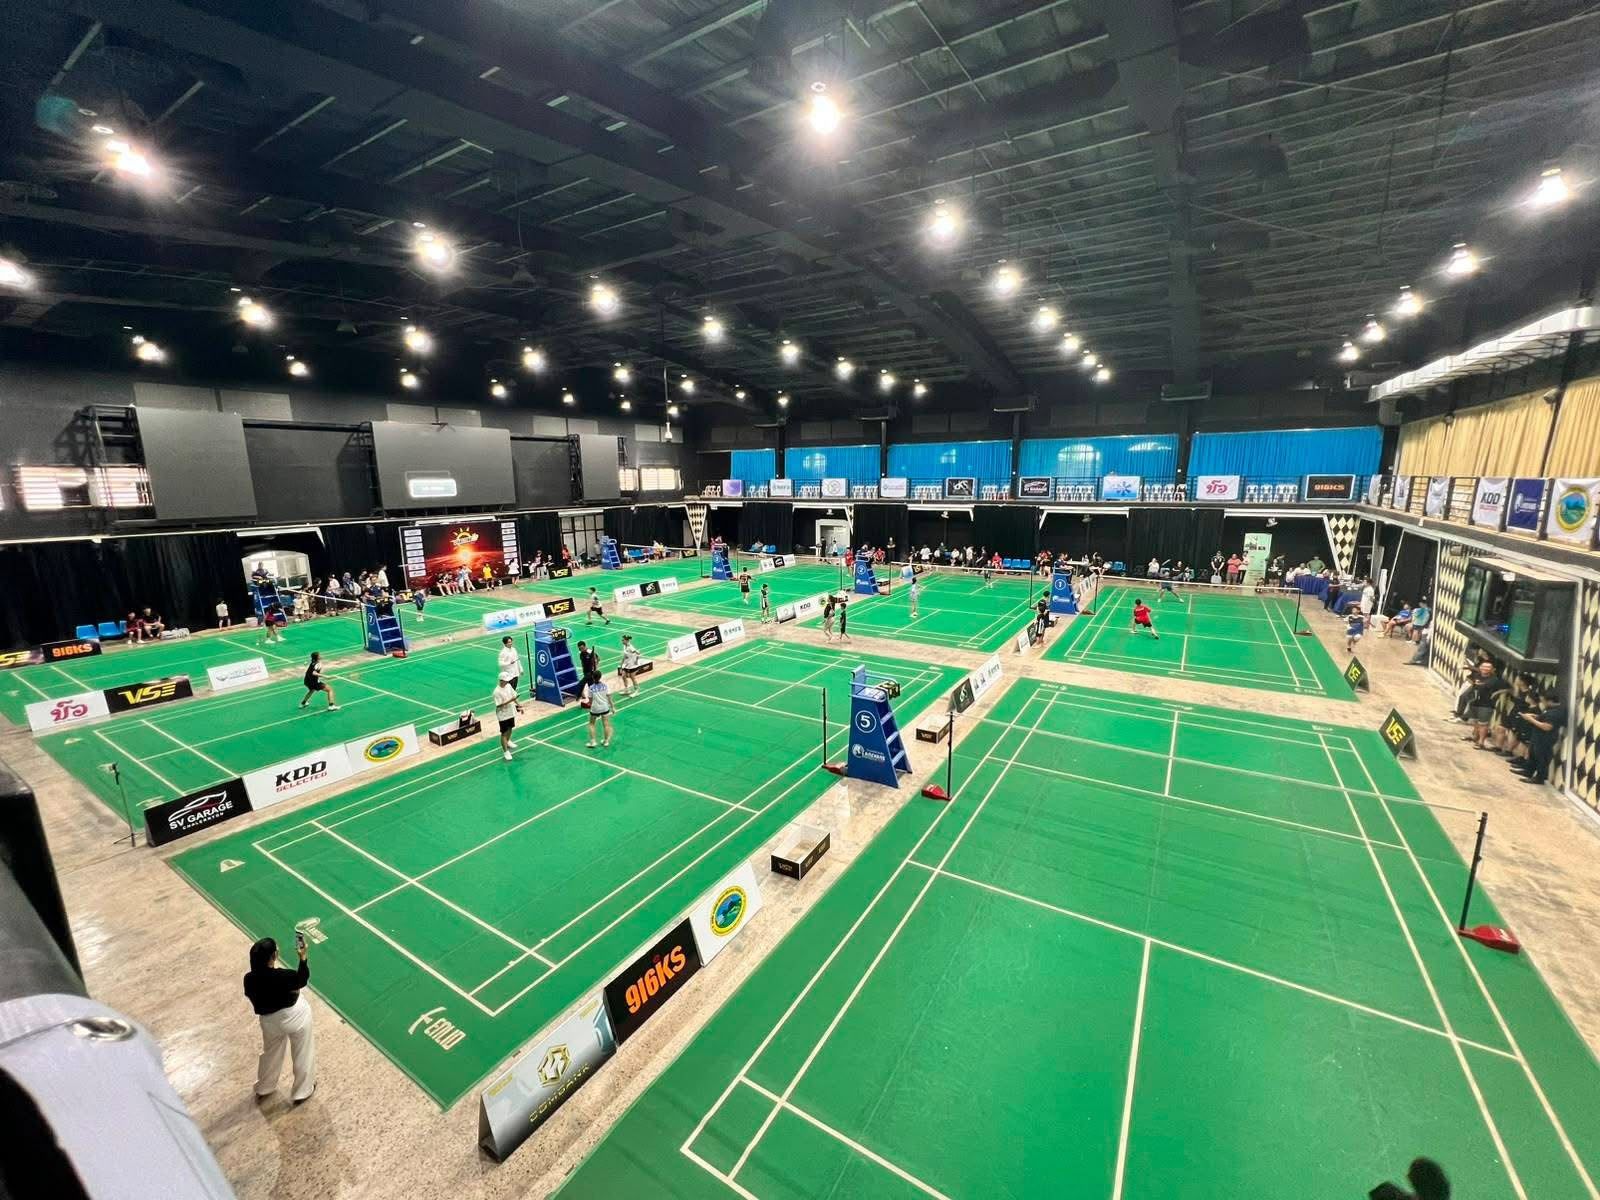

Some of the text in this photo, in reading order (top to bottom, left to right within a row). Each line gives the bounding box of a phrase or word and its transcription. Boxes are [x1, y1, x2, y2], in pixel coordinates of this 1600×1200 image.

[1480, 491, 1501, 505] KDD
[52, 643, 93, 658] 916KS
[118, 681, 177, 705] VSE
[860, 714, 871, 728] 5
[275, 760, 327, 787] KDD
[276, 771, 328, 793] SELECTED
[169, 800, 234, 830] SV GARAGE
[625, 945, 687, 1014] 916KS
